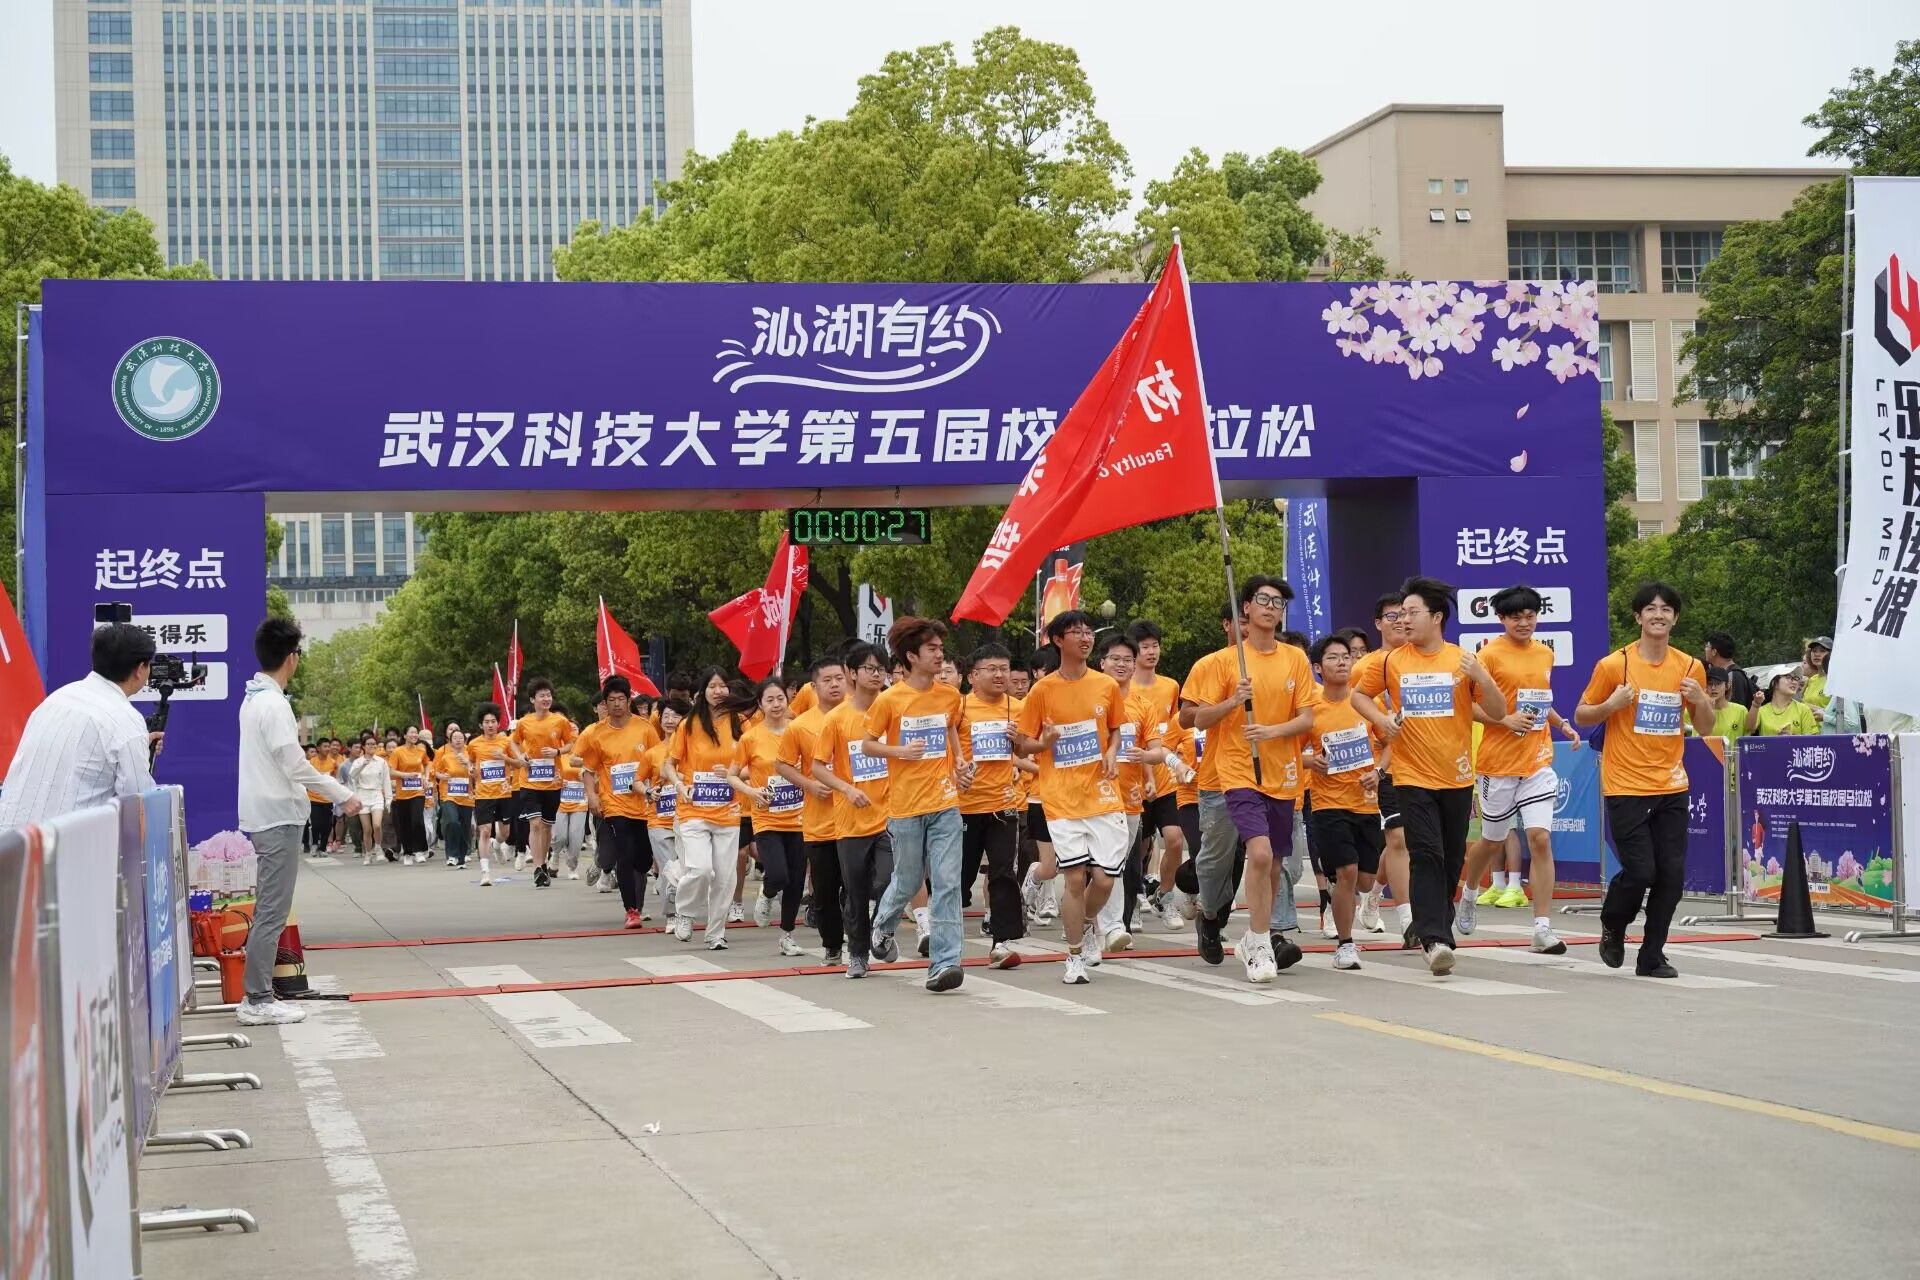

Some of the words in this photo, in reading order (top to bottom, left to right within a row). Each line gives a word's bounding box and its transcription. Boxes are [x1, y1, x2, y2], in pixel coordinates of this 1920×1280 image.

[1876, 379, 1894, 492] LEYOU
[794, 510, 927, 542] 00:00:27
[1456, 526, 1569, 567] 起终点
[94, 548, 227, 590] 起终点
[1851, 517, 1894, 630] MEDIA
[1302, 583, 1311, 614] SCIENCE
[1405, 692, 1451, 705] M0402
[904, 733, 946, 746] M179
[1056, 738, 1098, 756] M0422
[1328, 743, 1369, 762] M0192
[697, 787, 730, 797] F0674
